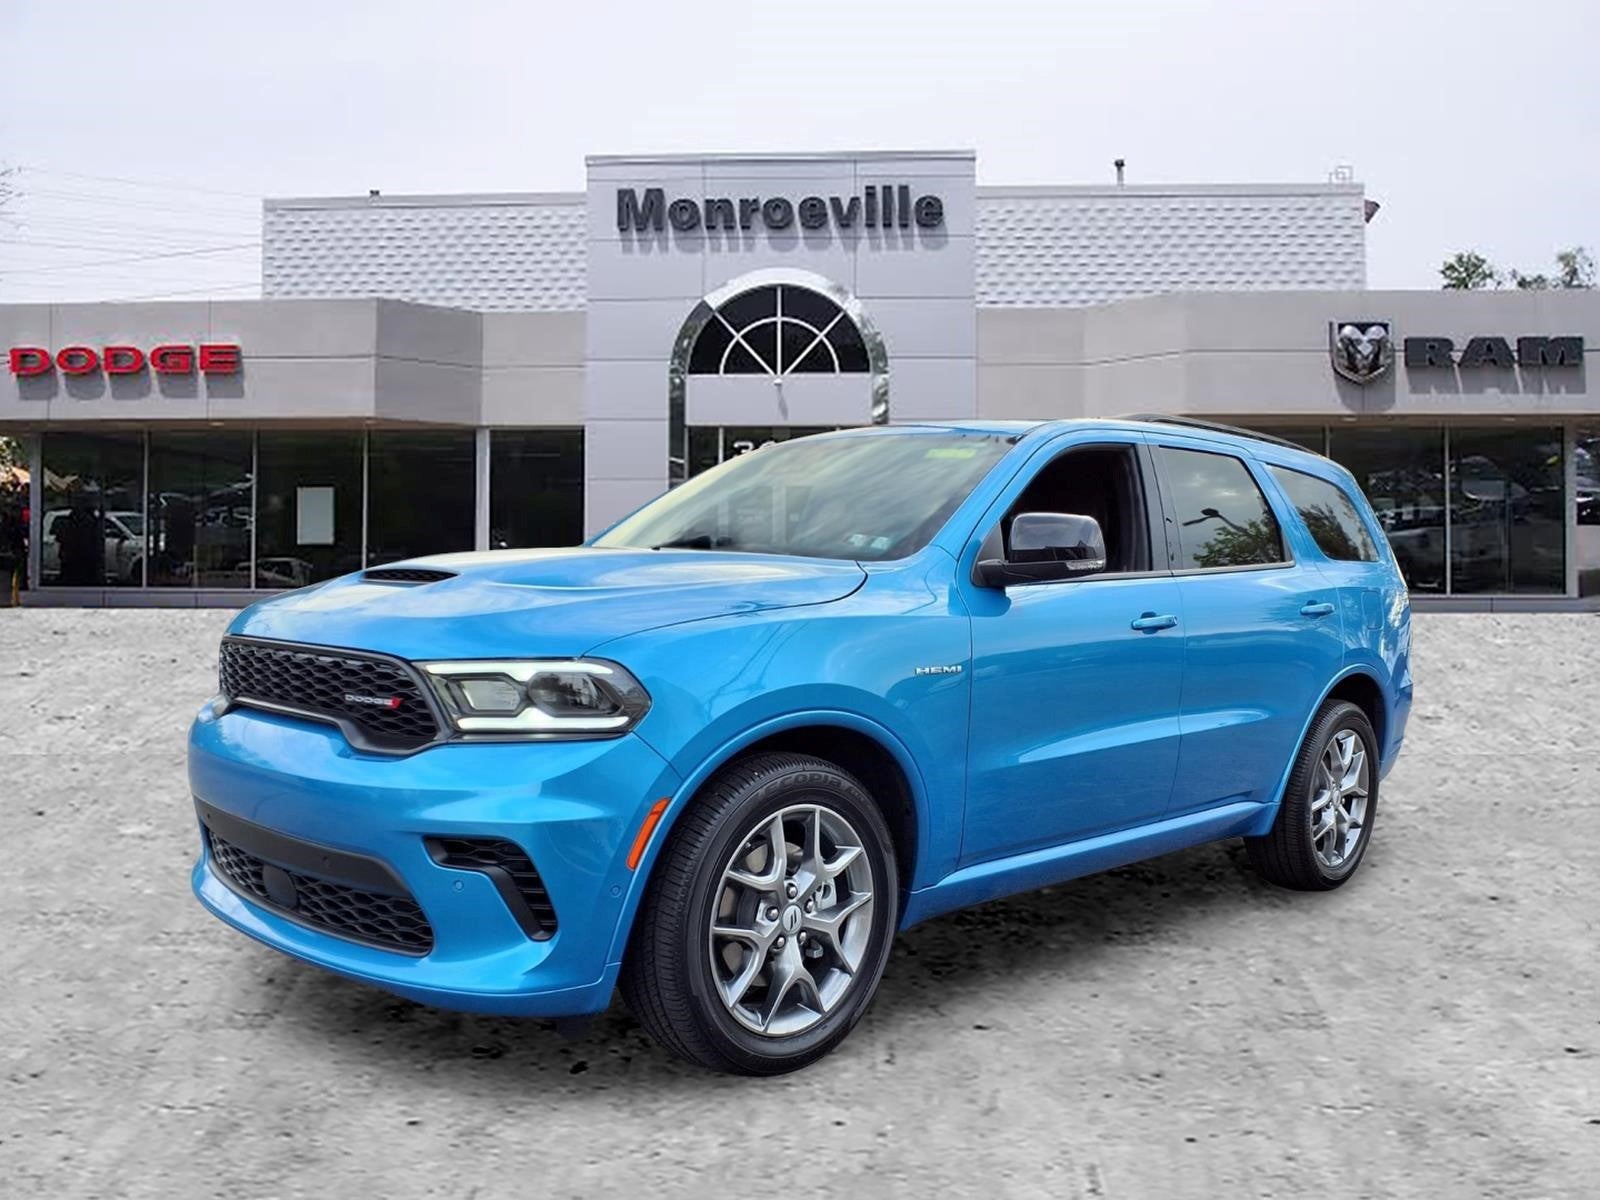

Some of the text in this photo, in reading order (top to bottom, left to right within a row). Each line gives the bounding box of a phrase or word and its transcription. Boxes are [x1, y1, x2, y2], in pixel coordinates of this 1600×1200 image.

[616, 185, 944, 231] Monroeville
[9, 344, 241, 374] DODGE
[1404, 336, 1585, 367] RAM
[915, 665, 963, 675] HEMI
[345, 694, 393, 706] DODGE
